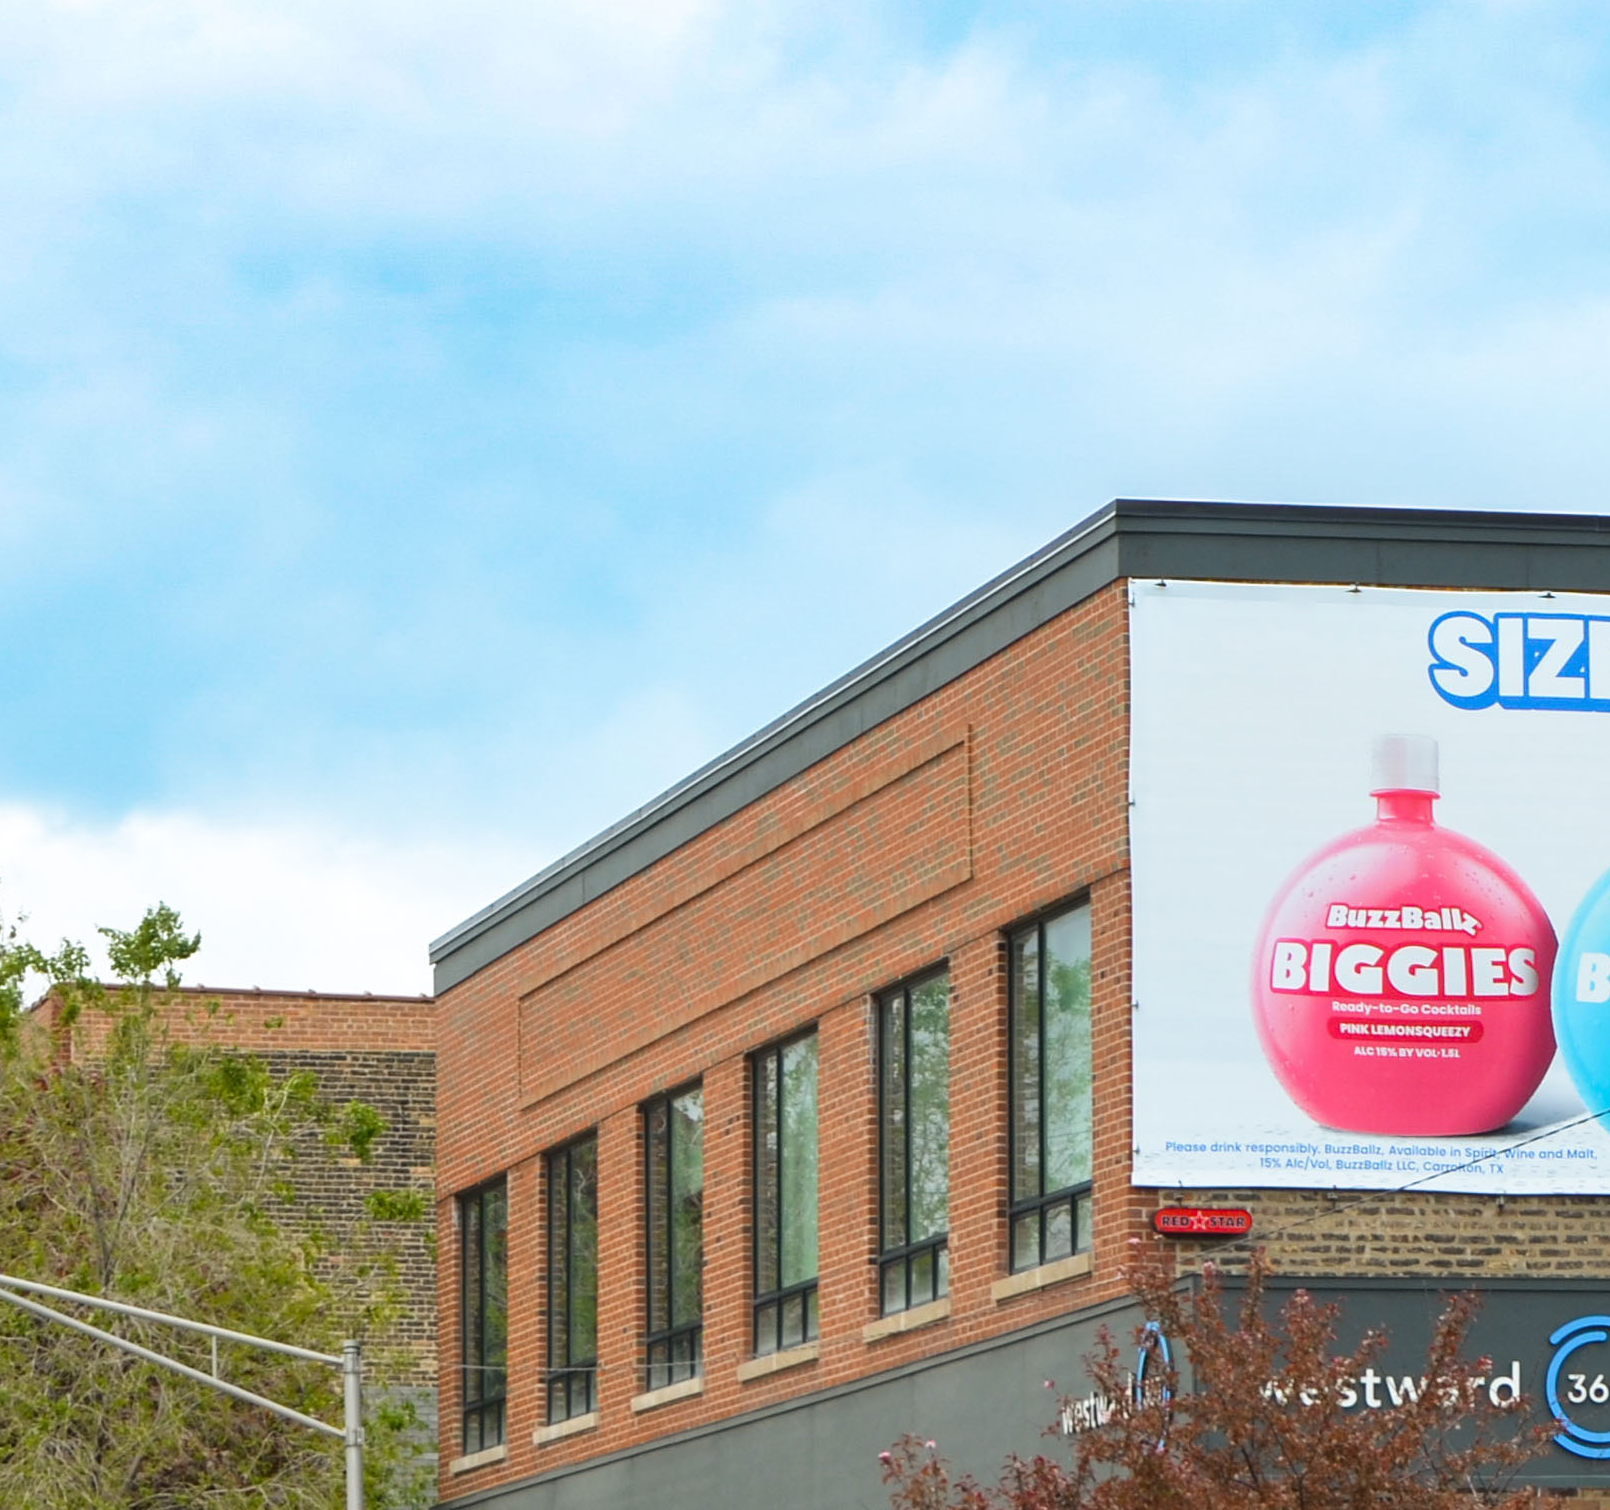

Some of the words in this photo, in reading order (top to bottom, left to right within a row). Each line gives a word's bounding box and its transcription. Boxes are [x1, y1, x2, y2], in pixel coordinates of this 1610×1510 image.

[1327, 904, 1482, 936] BuzzBallz
[1272, 941, 1539, 997] BIGGIES
[1332, 1001, 1418, 1016] Ready-to-Go
[1421, 1003, 1481, 1016] Cocktails
[1340, 1023, 1369, 1035] PINK
[1371, 1024, 1470, 1038] LEMONSQUEEZY
[1354, 1046, 1374, 1056] ALC
[1375, 1046, 1398, 1057] 15%
[1399, 1047, 1414, 1057] BY
[1165, 1141, 1206, 1152] Please
[1210, 1142, 1241, 1152] drink
[1389, 1145, 1446, 1157] Available
[1450, 1145, 1461, 1157] in
[1505, 1148, 1535, 1159] Wine
[1539, 1149, 1563, 1159] and
[1260, 1157, 1281, 1168] 15%
[1336, 1159, 1392, 1171] BuzzBallz
[1396, 1160, 1418, 1173] LLC,
[1490, 1164, 1504, 1174] TX
[1162, 1216, 1190, 1226] RED
[1210, 1217, 1245, 1227] STAR
